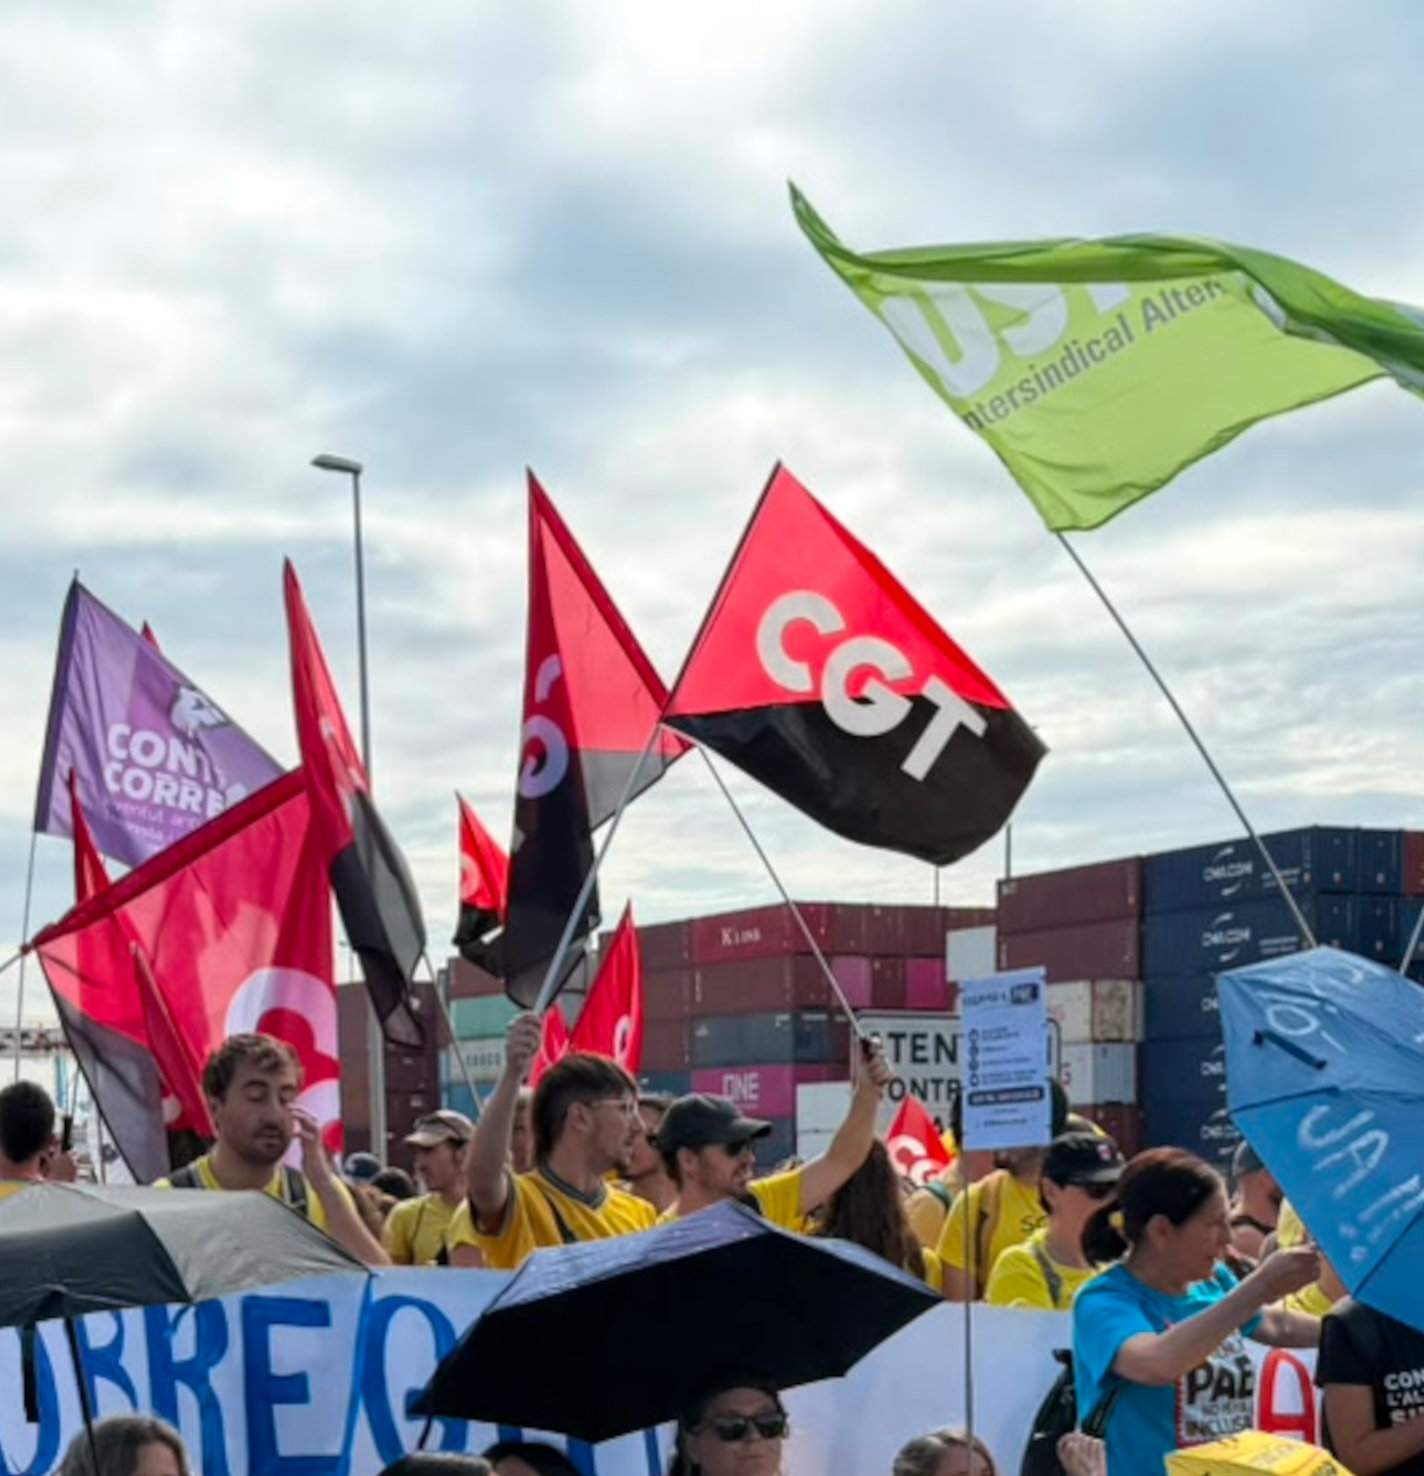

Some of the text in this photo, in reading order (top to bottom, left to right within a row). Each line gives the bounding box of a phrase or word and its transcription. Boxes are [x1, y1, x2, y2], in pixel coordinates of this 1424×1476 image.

[960, 311, 1134, 434] ntersindical
[756, 589, 988, 782] CGT
[721, 1072, 761, 1101] ONE
